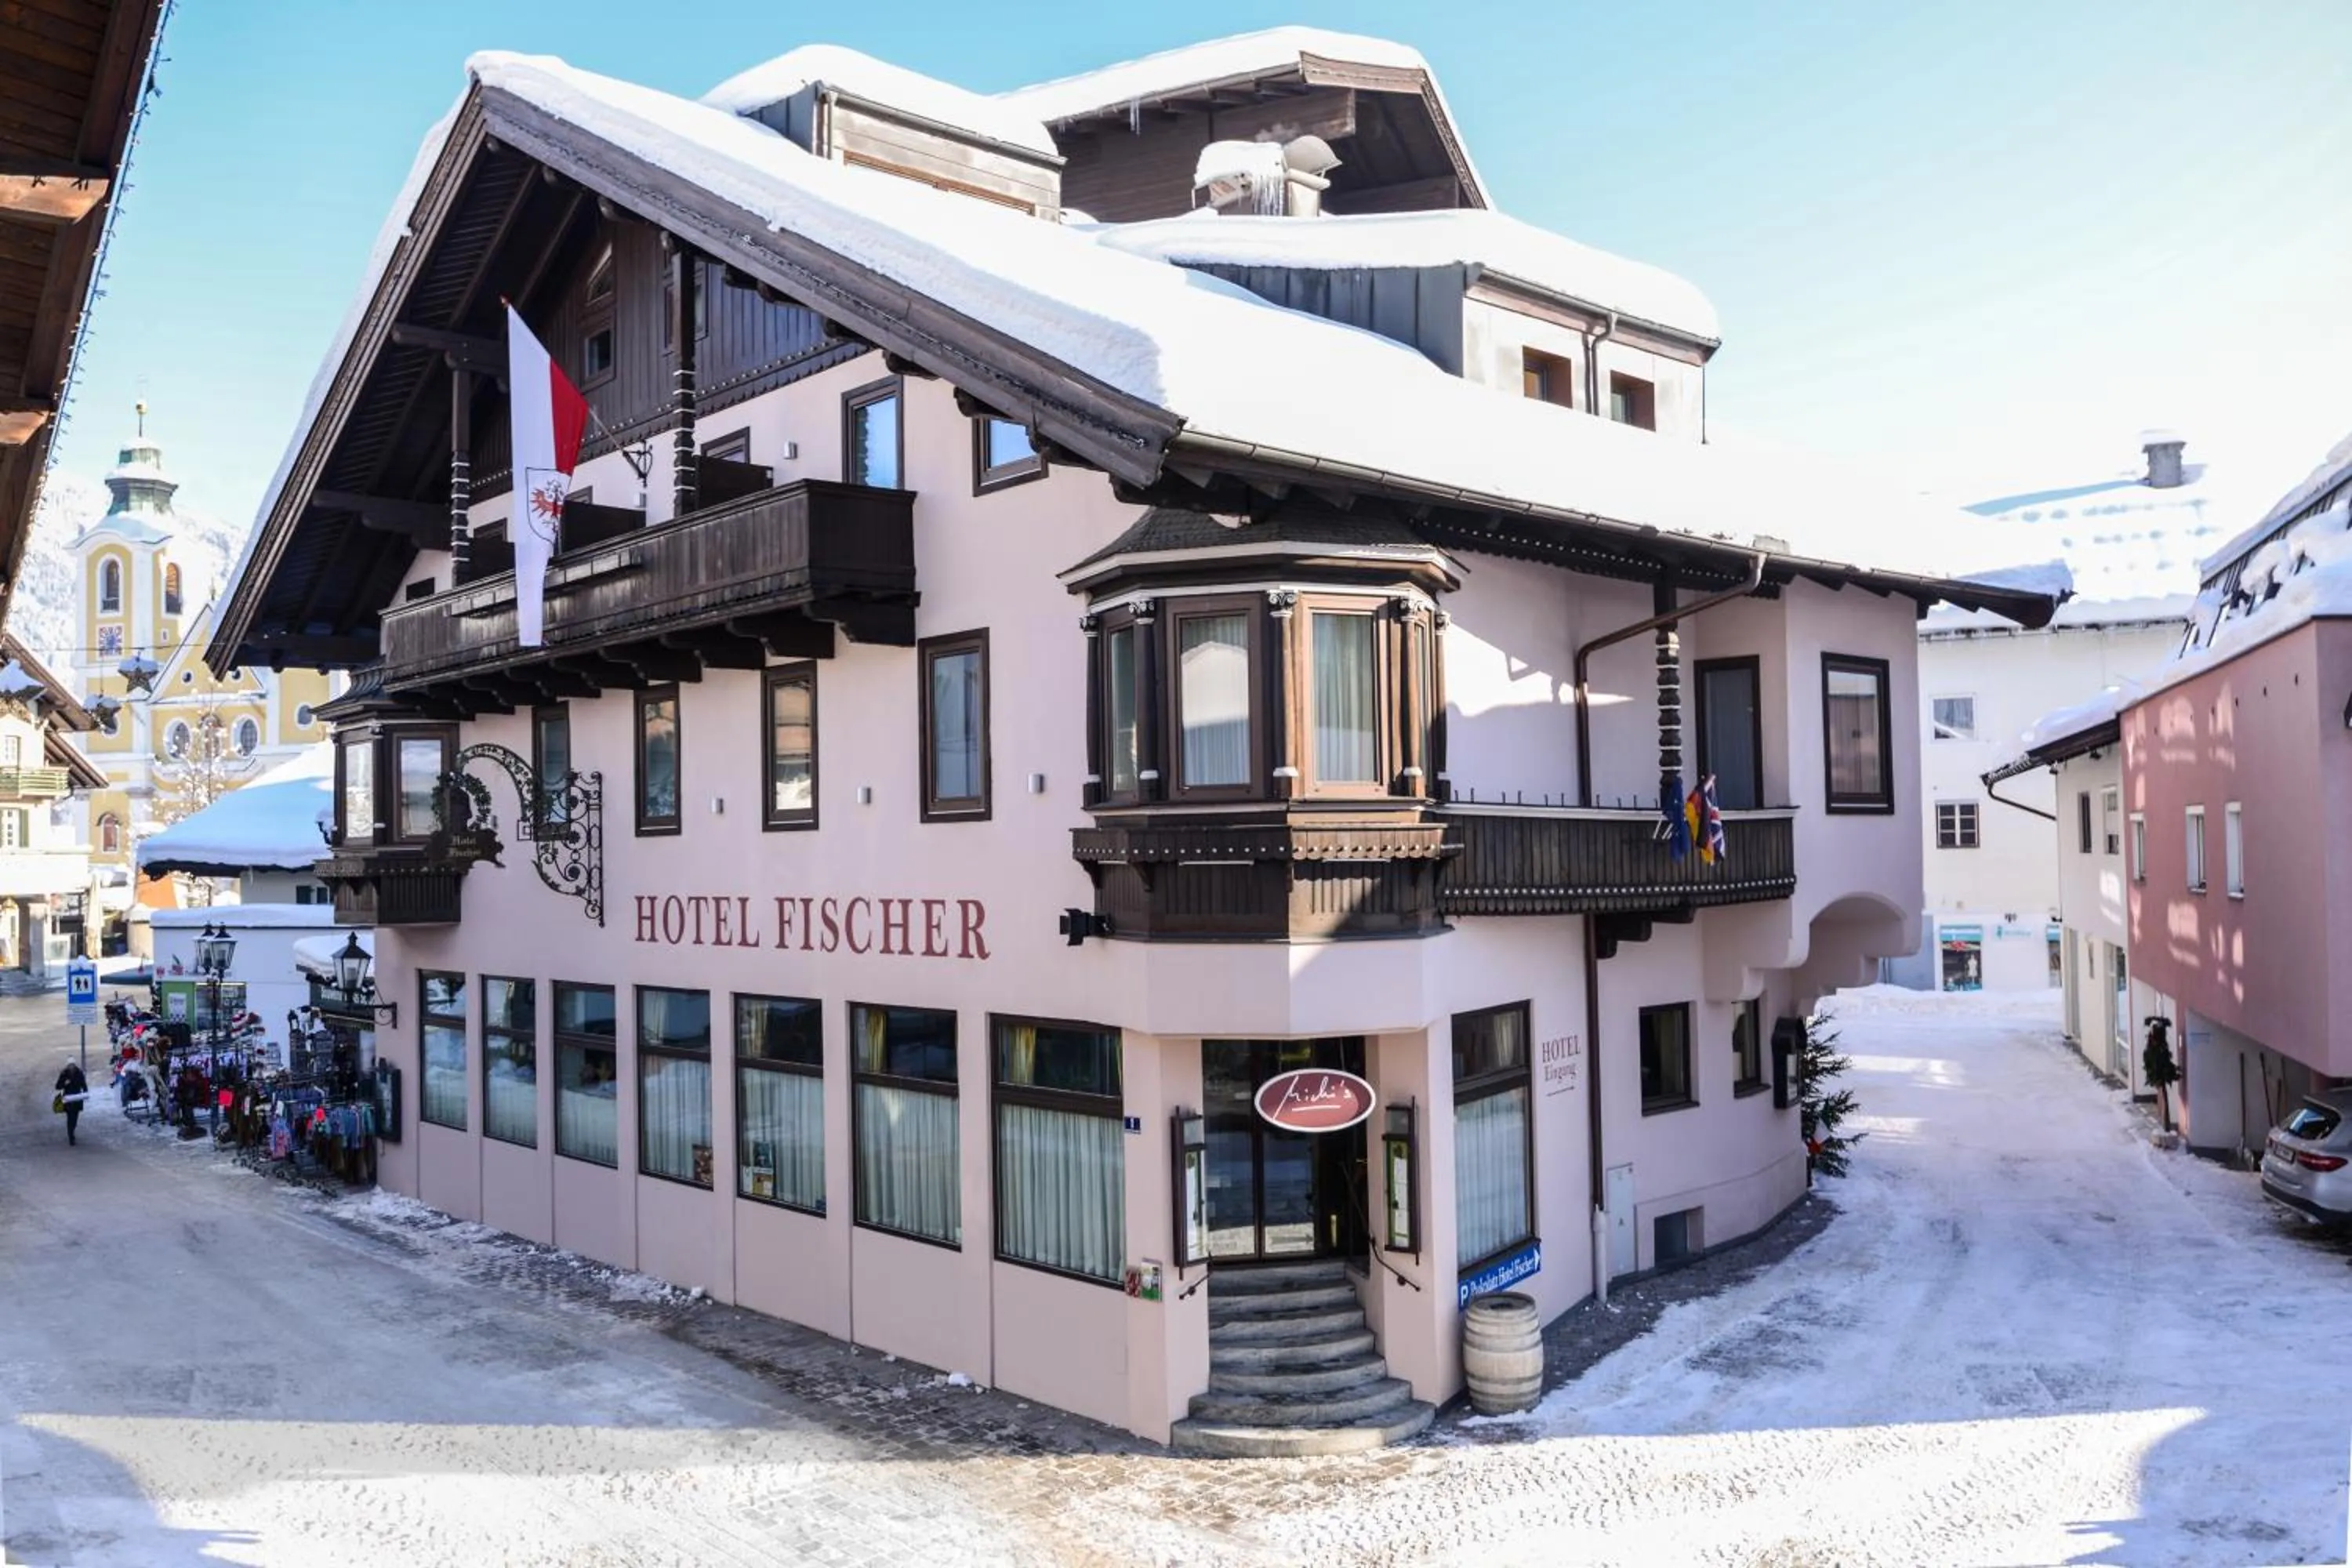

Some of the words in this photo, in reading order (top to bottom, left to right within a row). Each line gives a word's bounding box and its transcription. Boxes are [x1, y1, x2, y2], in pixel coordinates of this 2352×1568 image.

[634, 895, 760, 948] HOTEL
[774, 896, 991, 960] FISCHER
[1542, 1035, 1581, 1062] HOTEL
[1461, 1285, 1468, 1305] P
